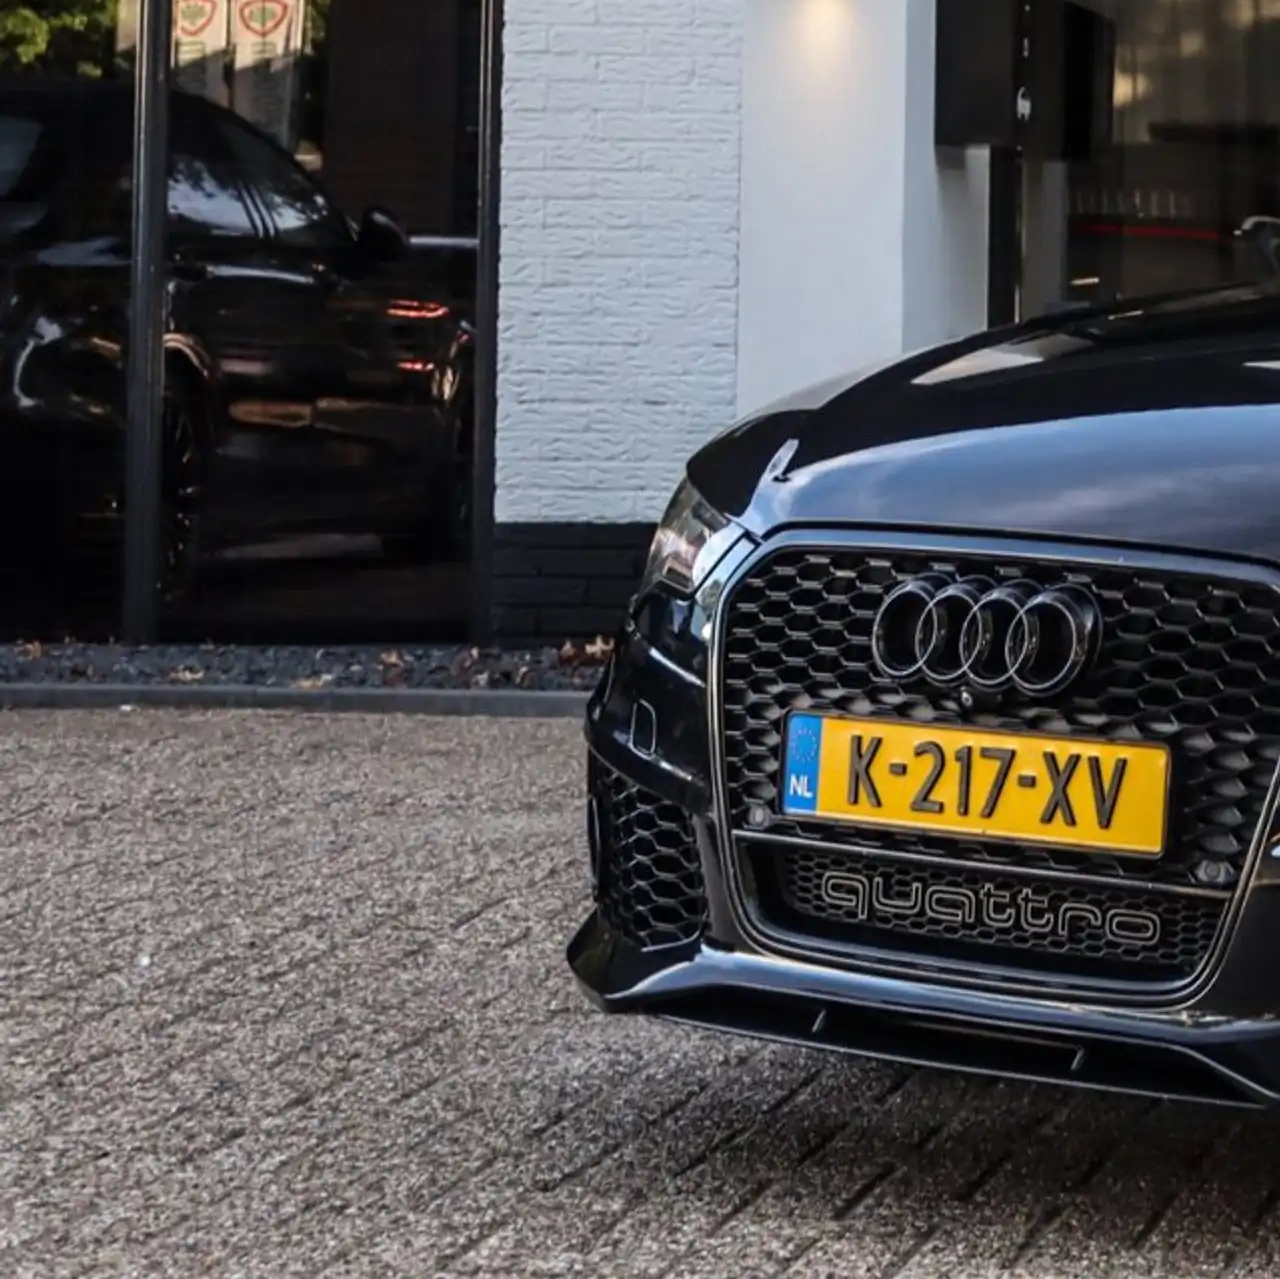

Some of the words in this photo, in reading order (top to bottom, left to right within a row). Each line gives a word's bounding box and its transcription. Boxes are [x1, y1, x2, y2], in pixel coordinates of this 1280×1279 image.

[789, 774, 813, 799] NL
[847, 734, 1128, 830] K-217-XV
[822, 871, 1161, 945] quattro
